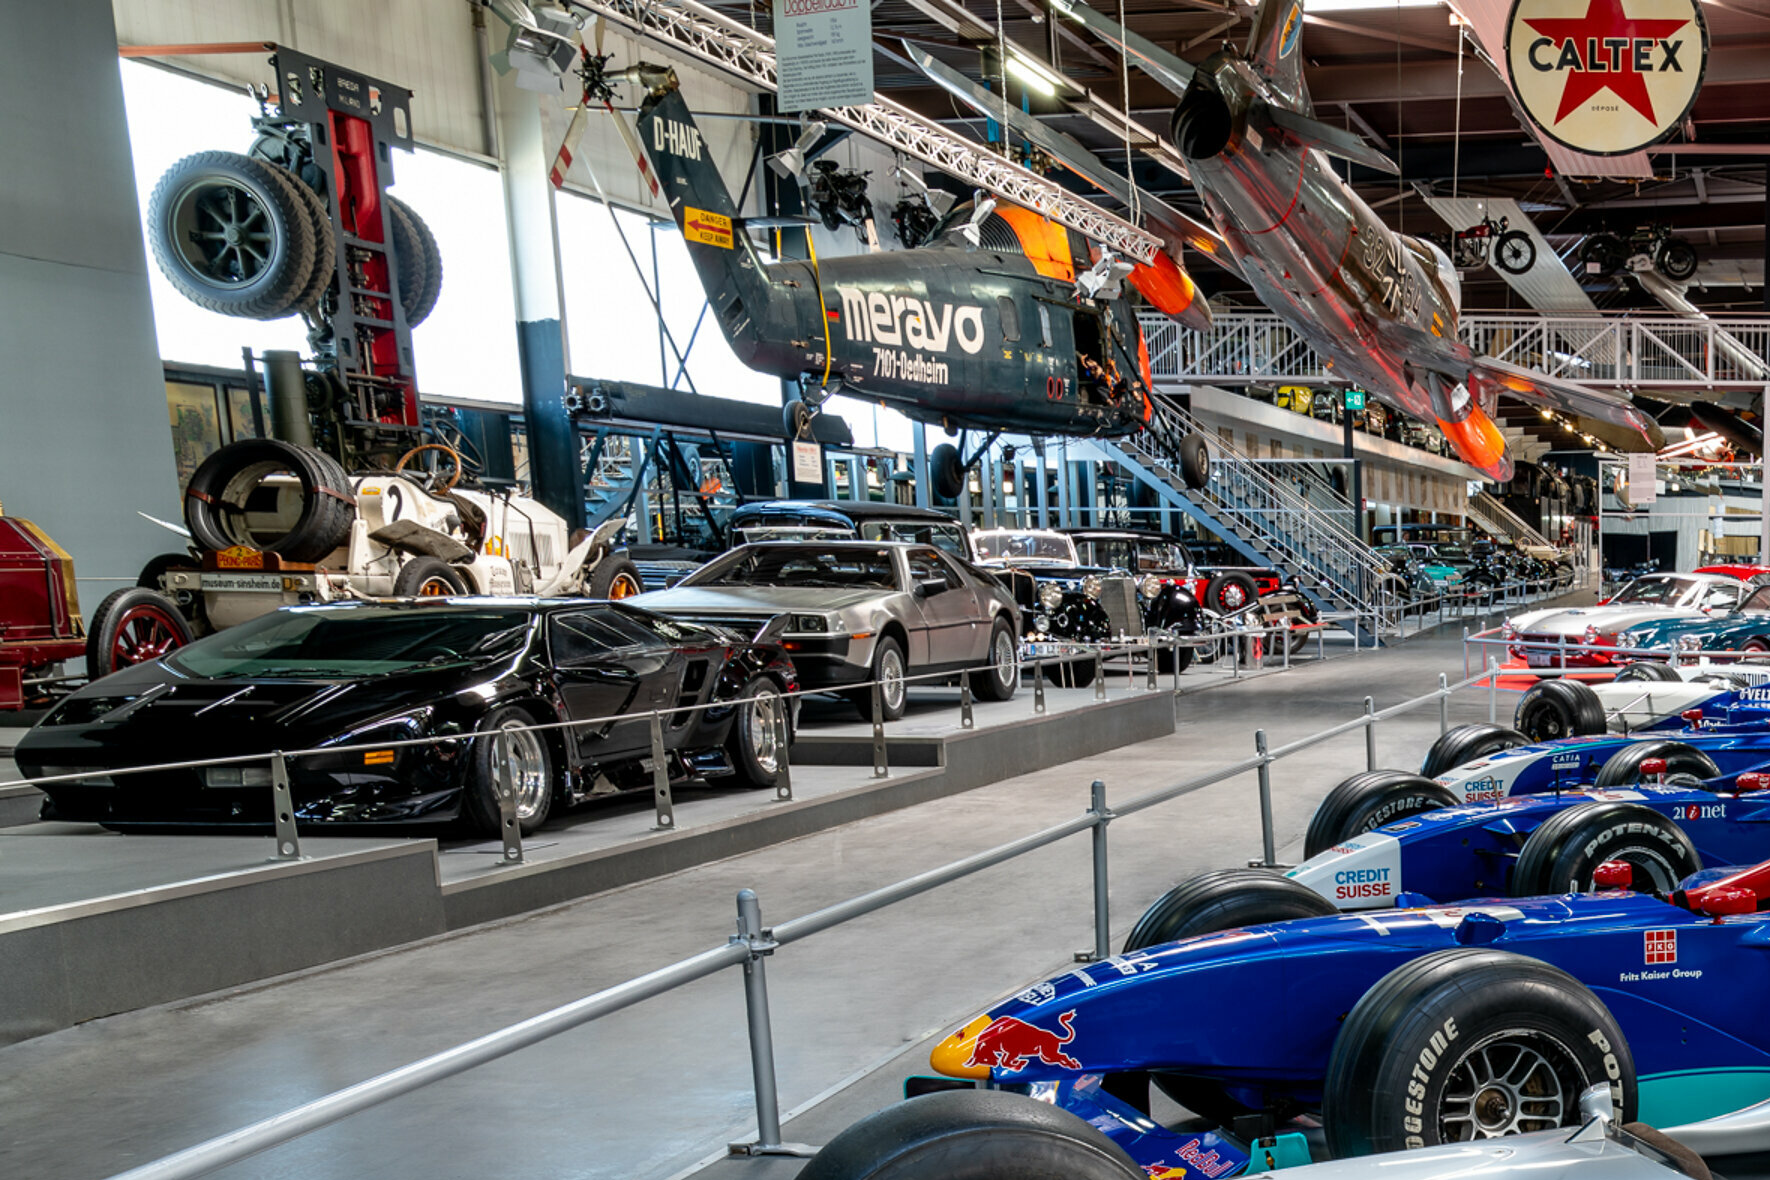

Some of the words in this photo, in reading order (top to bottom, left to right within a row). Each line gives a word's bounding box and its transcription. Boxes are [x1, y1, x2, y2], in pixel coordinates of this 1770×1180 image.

[1528, 37, 1683, 72] CALTEX
[699, 212, 729, 227] DANGER
[699, 231, 714, 242] KEEP
[715, 234, 730, 245] AWAY
[835, 281, 985, 354] meravo
[201, 577, 281, 590] museum-sinsheim.de
[1553, 754, 1581, 763] CATIA
[1465, 780, 1504, 793] CREDIT
[1585, 823, 1686, 859] POTENZA
[1335, 868, 1390, 885] CREDIT
[1336, 883, 1391, 899] SUISSE
[1620, 973, 1640, 982] Fritz
[1641, 970, 1670, 980] Kaiser
[1672, 968, 1703, 979] Group
